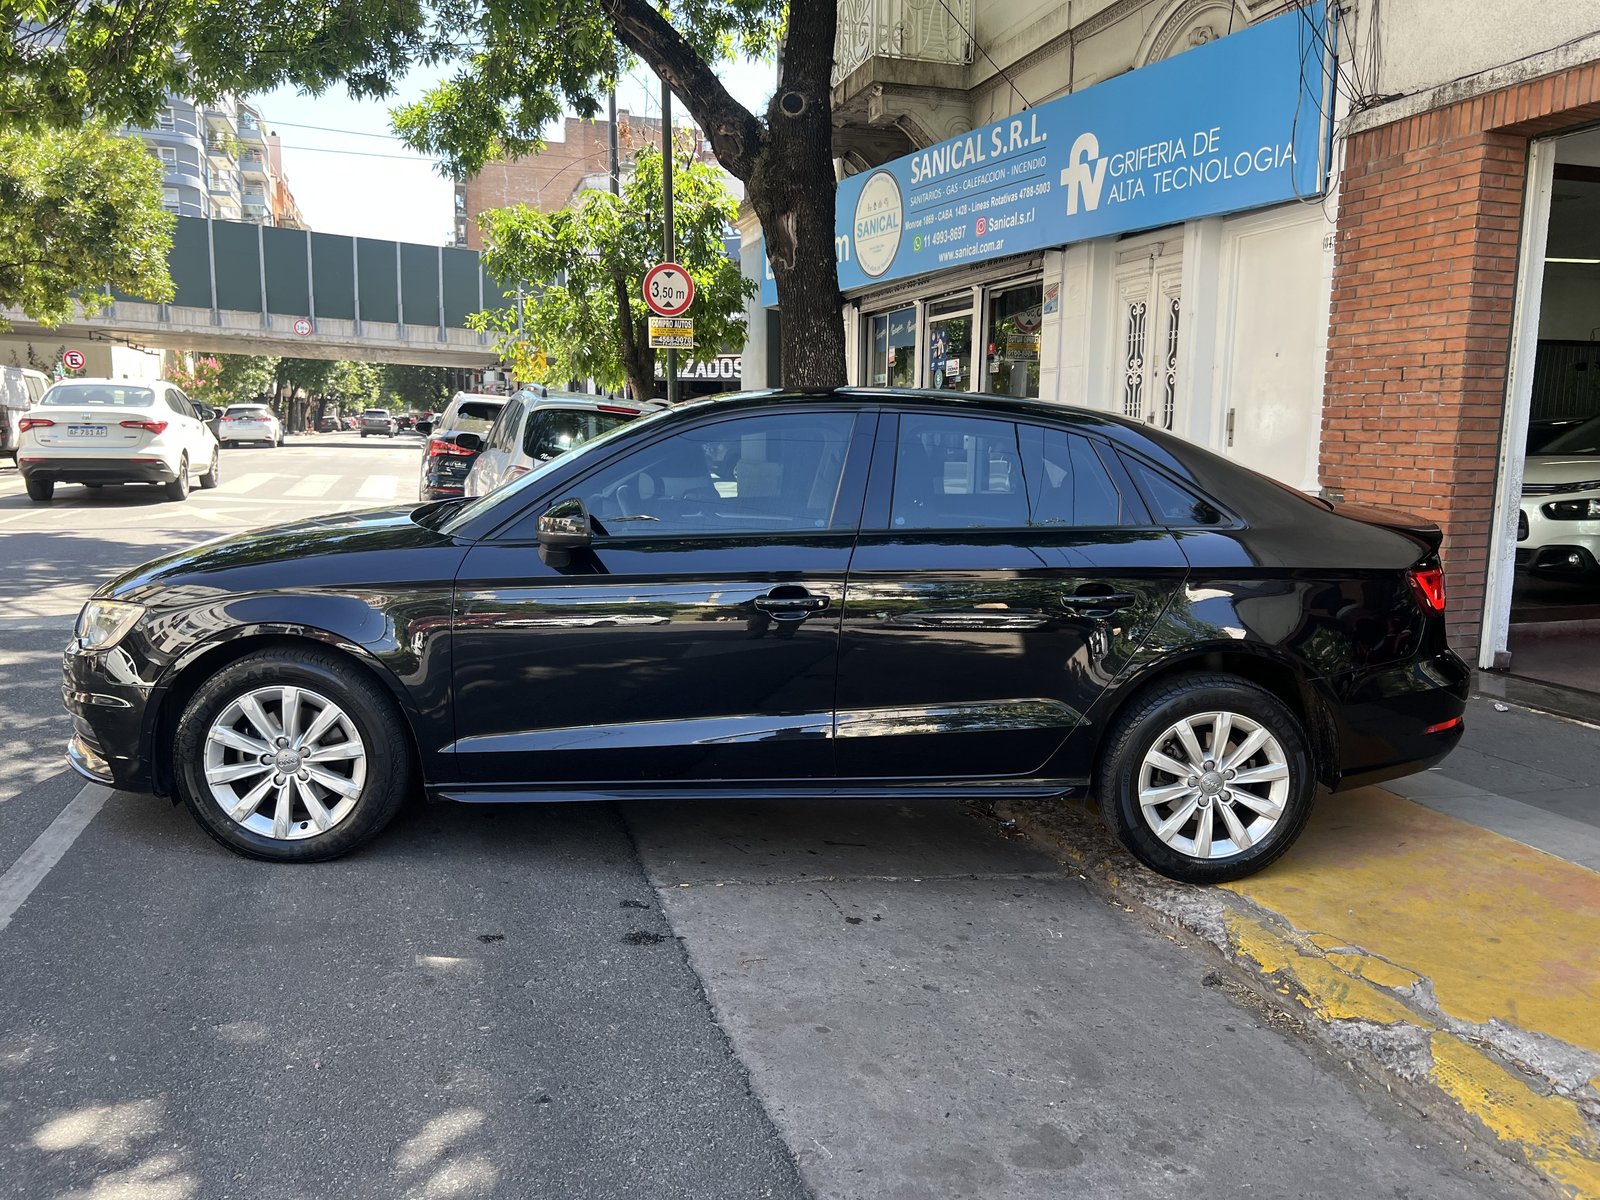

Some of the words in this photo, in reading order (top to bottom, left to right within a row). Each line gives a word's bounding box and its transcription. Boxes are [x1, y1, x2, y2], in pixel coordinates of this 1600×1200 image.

[911, 133, 986, 184] SANICAL
[990, 113, 1047, 157] S.R.L.
[1109, 138, 1187, 177] GRIFERIA
[1193, 127, 1220, 157] DE
[910, 187, 942, 207] SANITARIOS
[946, 183, 958, 195] GAS
[962, 169, 1005, 190] CALEFACCION
[1011, 156, 1046, 176] INCENDIO
[1108, 176, 1145, 205] ALTA
[1153, 142, 1297, 194] TECNOLOGIA
[938, 208, 952, 222] CABA
[991, 192, 1018, 208] Rotativas
[857, 213, 899, 238] SANICAL
[924, 236, 930, 248] 11
[938, 238, 1004, 262] www.sanical.com.ar
[652, 281, 673, 299] 3,50
[676, 290, 685, 299] m
[652, 319, 673, 328] COMPRO
[674, 320, 692, 329] AUTOS
